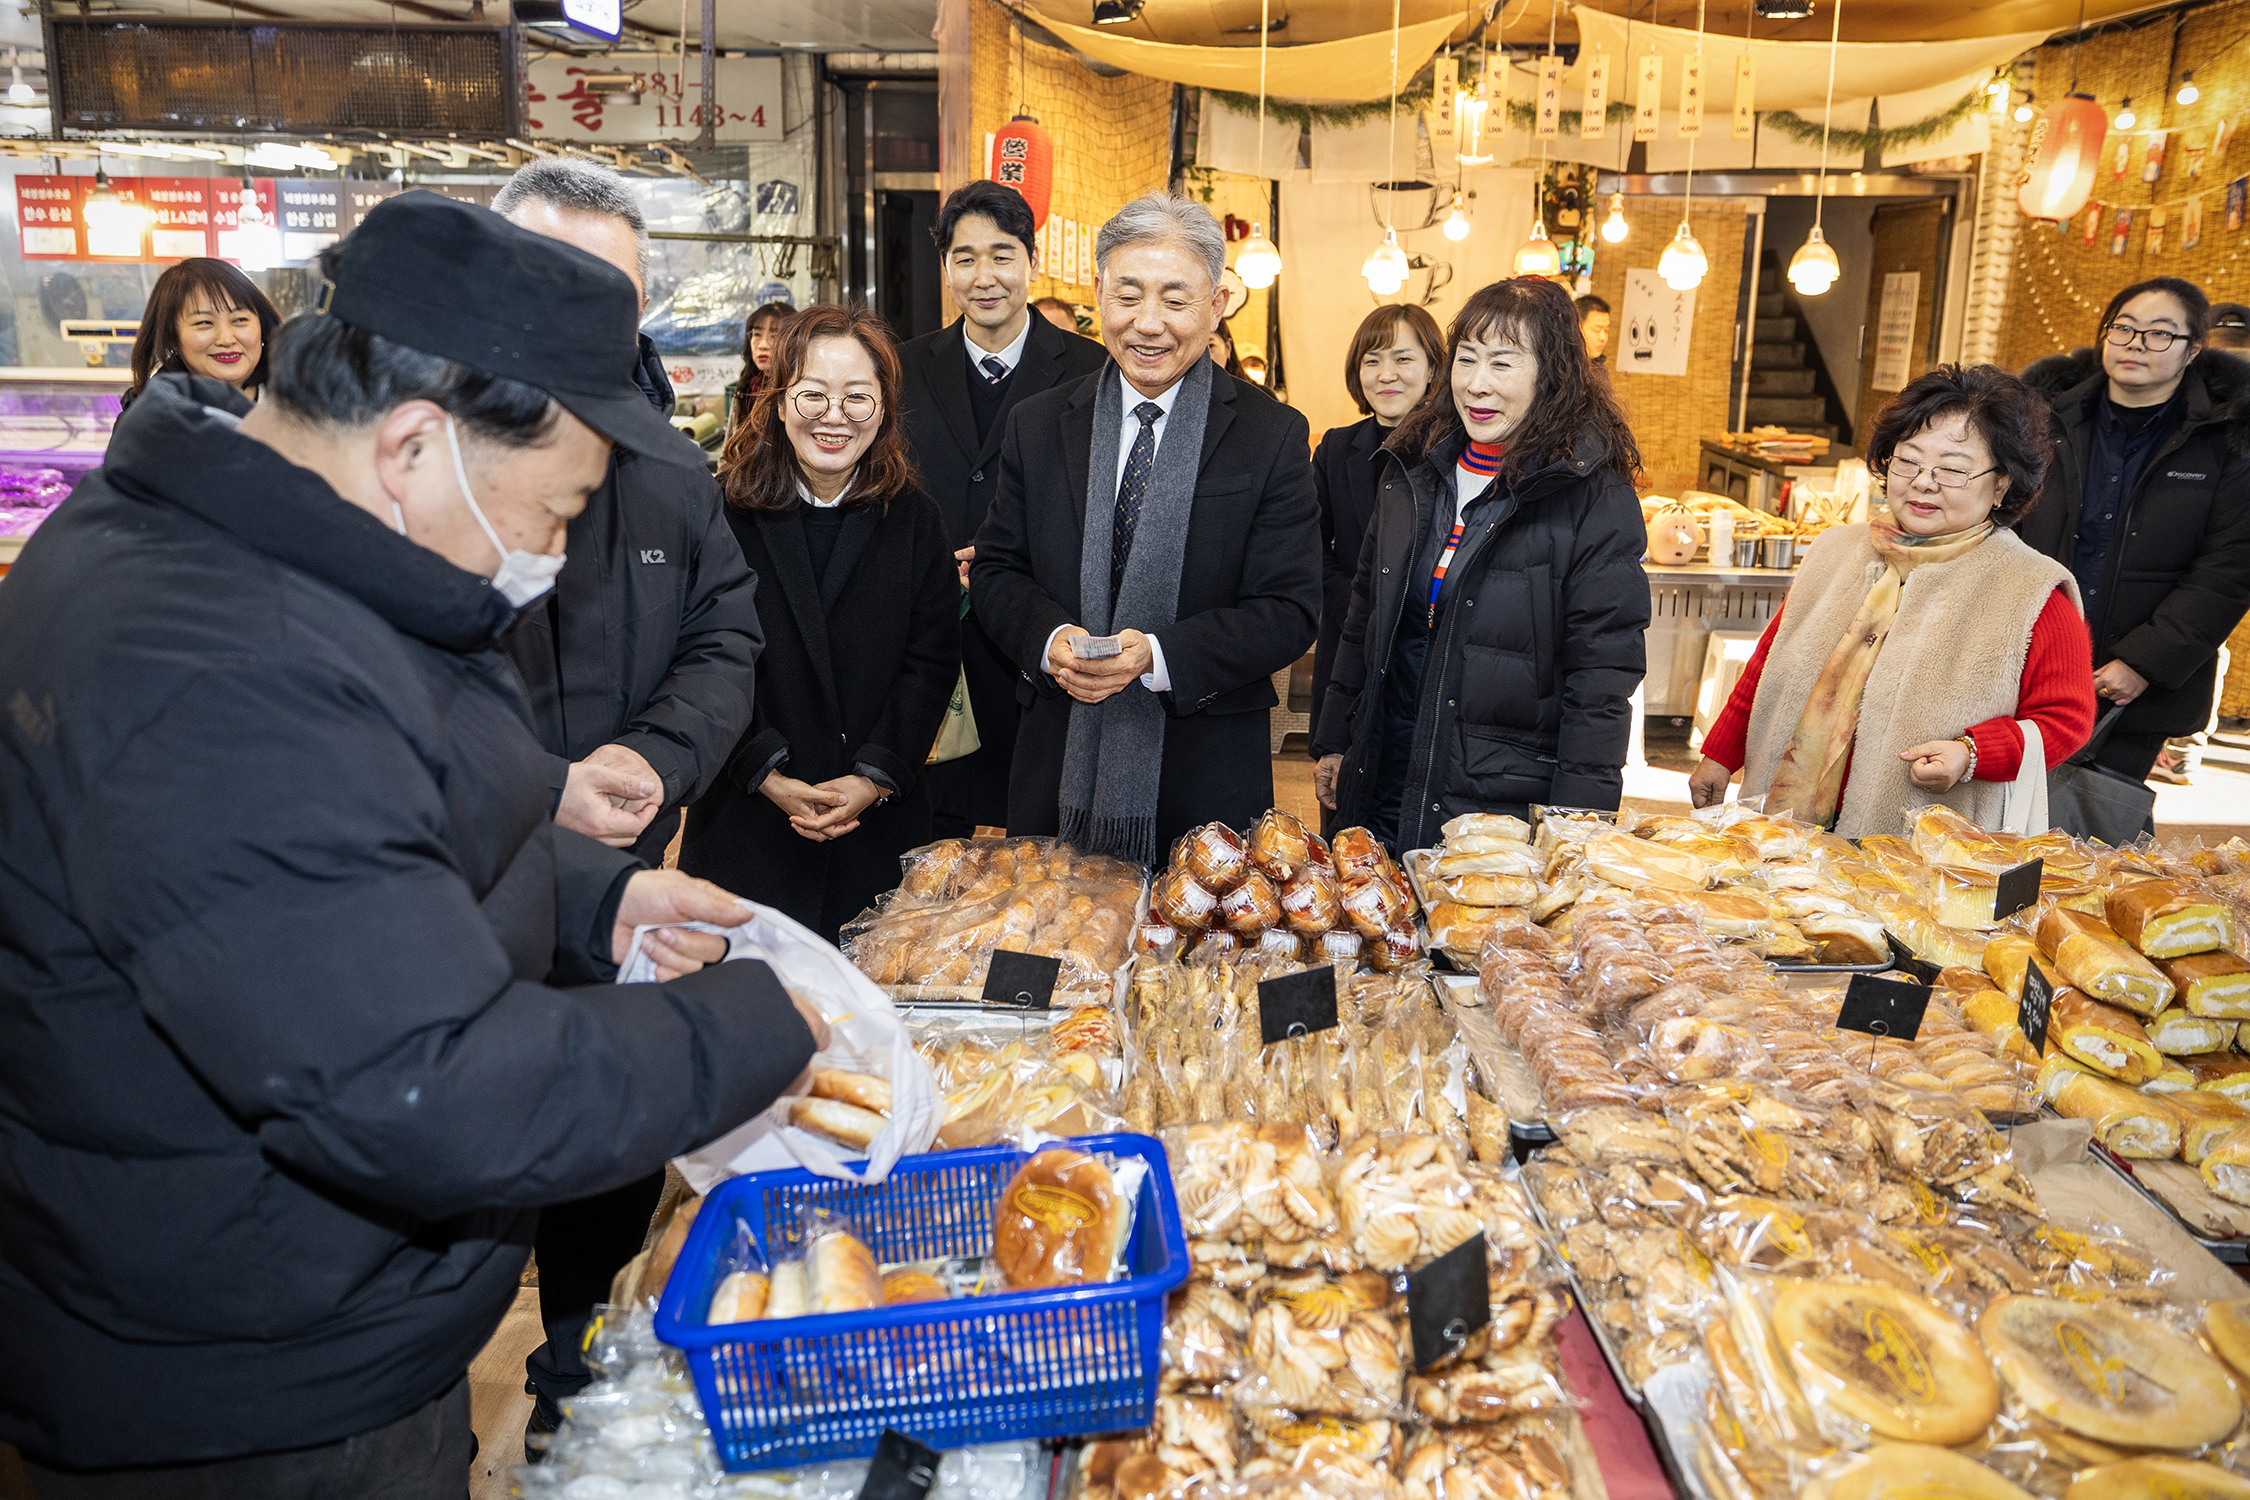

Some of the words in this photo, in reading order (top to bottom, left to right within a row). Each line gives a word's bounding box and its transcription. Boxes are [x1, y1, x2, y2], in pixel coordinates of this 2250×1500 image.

[1592, 68, 1601, 99] 튀김
[1441, 73, 1451, 120] 소떡소떡
[1491, 70, 1502, 117] 떡꼬치
[1545, 70, 1556, 118] 피카츄
[656, 105, 767, 129] 1143~4
[1583, 125, 1602, 133] 2,000
[1638, 127, 1656, 135] 4,000
[1680, 125, 1699, 133] 4,000
[23, 206, 48, 221] 한우
[49, 207, 72, 222] 등심
[213, 210, 237, 225] 수입
[285, 211, 311, 227] 한돈
[312, 211, 337, 228] 삼겹
[2167, 471, 2207, 480] Discovery
[640, 549, 666, 564] K2
